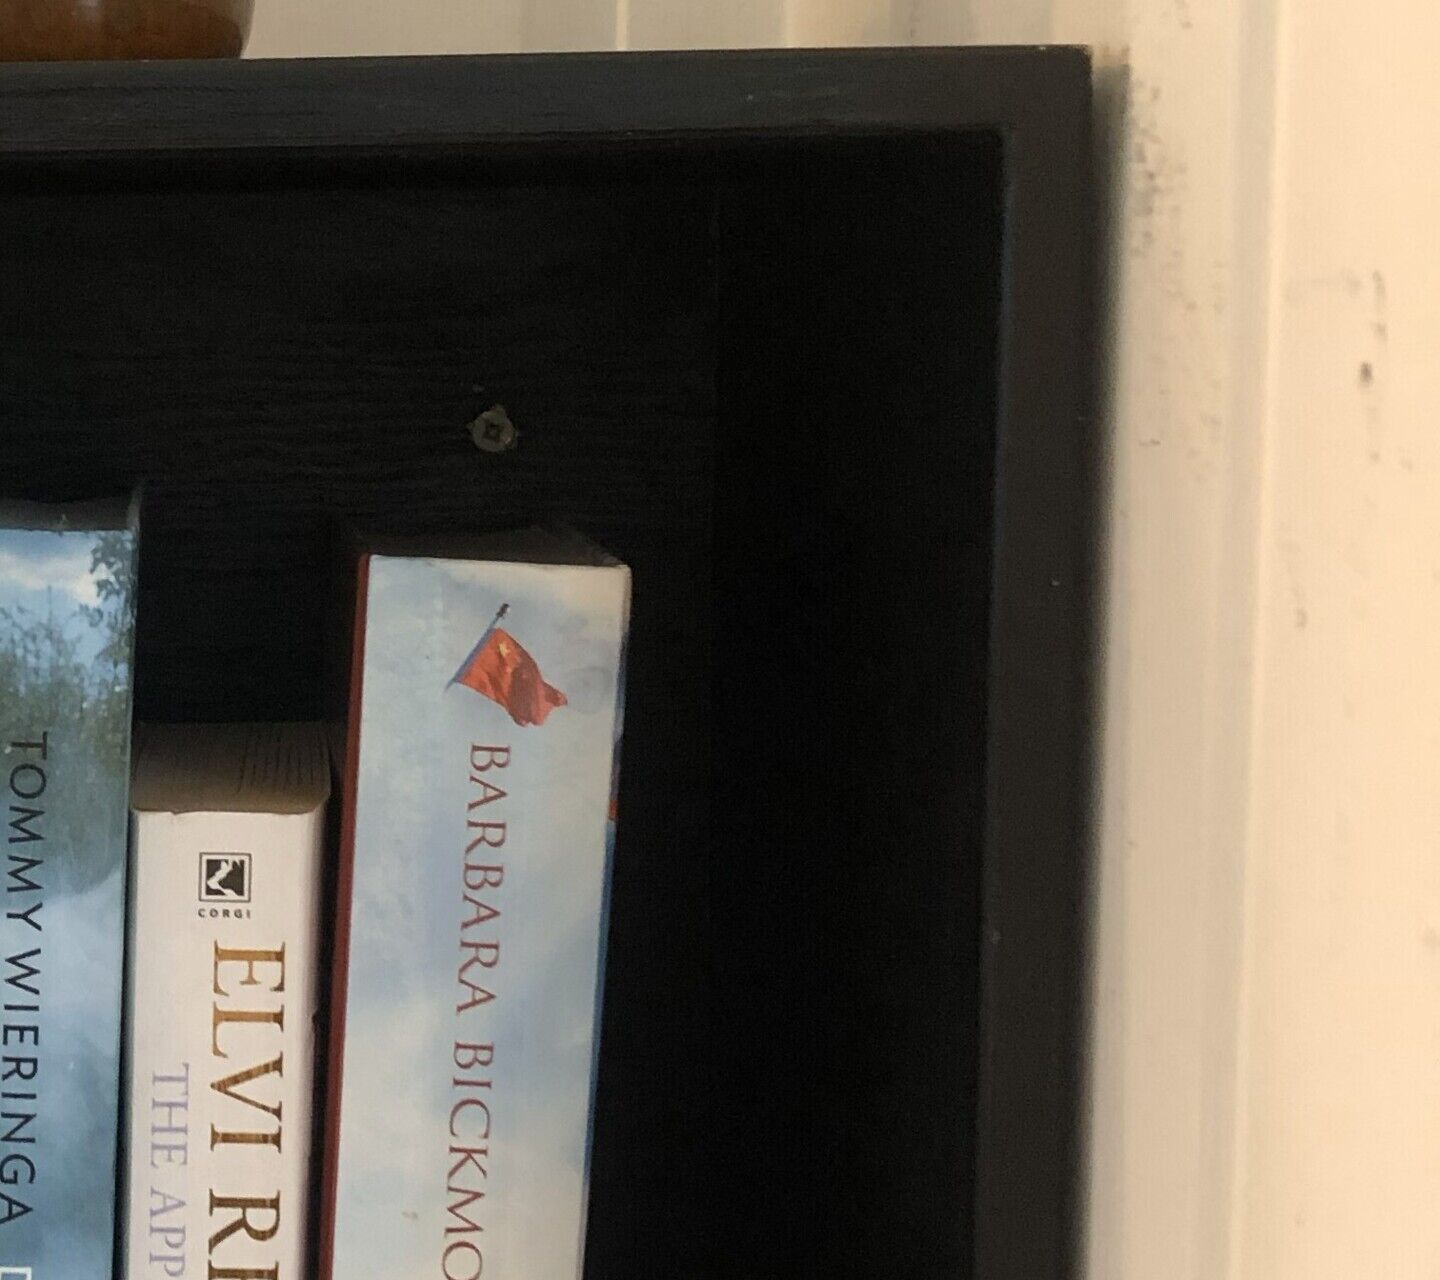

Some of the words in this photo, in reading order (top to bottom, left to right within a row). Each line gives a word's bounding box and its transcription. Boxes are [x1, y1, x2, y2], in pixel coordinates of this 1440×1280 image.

[4, 731, 49, 932] TOMMY
[197, 907, 252, 920] CORGI
[457, 743, 511, 1016] BARBARA
[149, 1062, 190, 1170] THE
[210, 939, 287, 1153] ELVI
